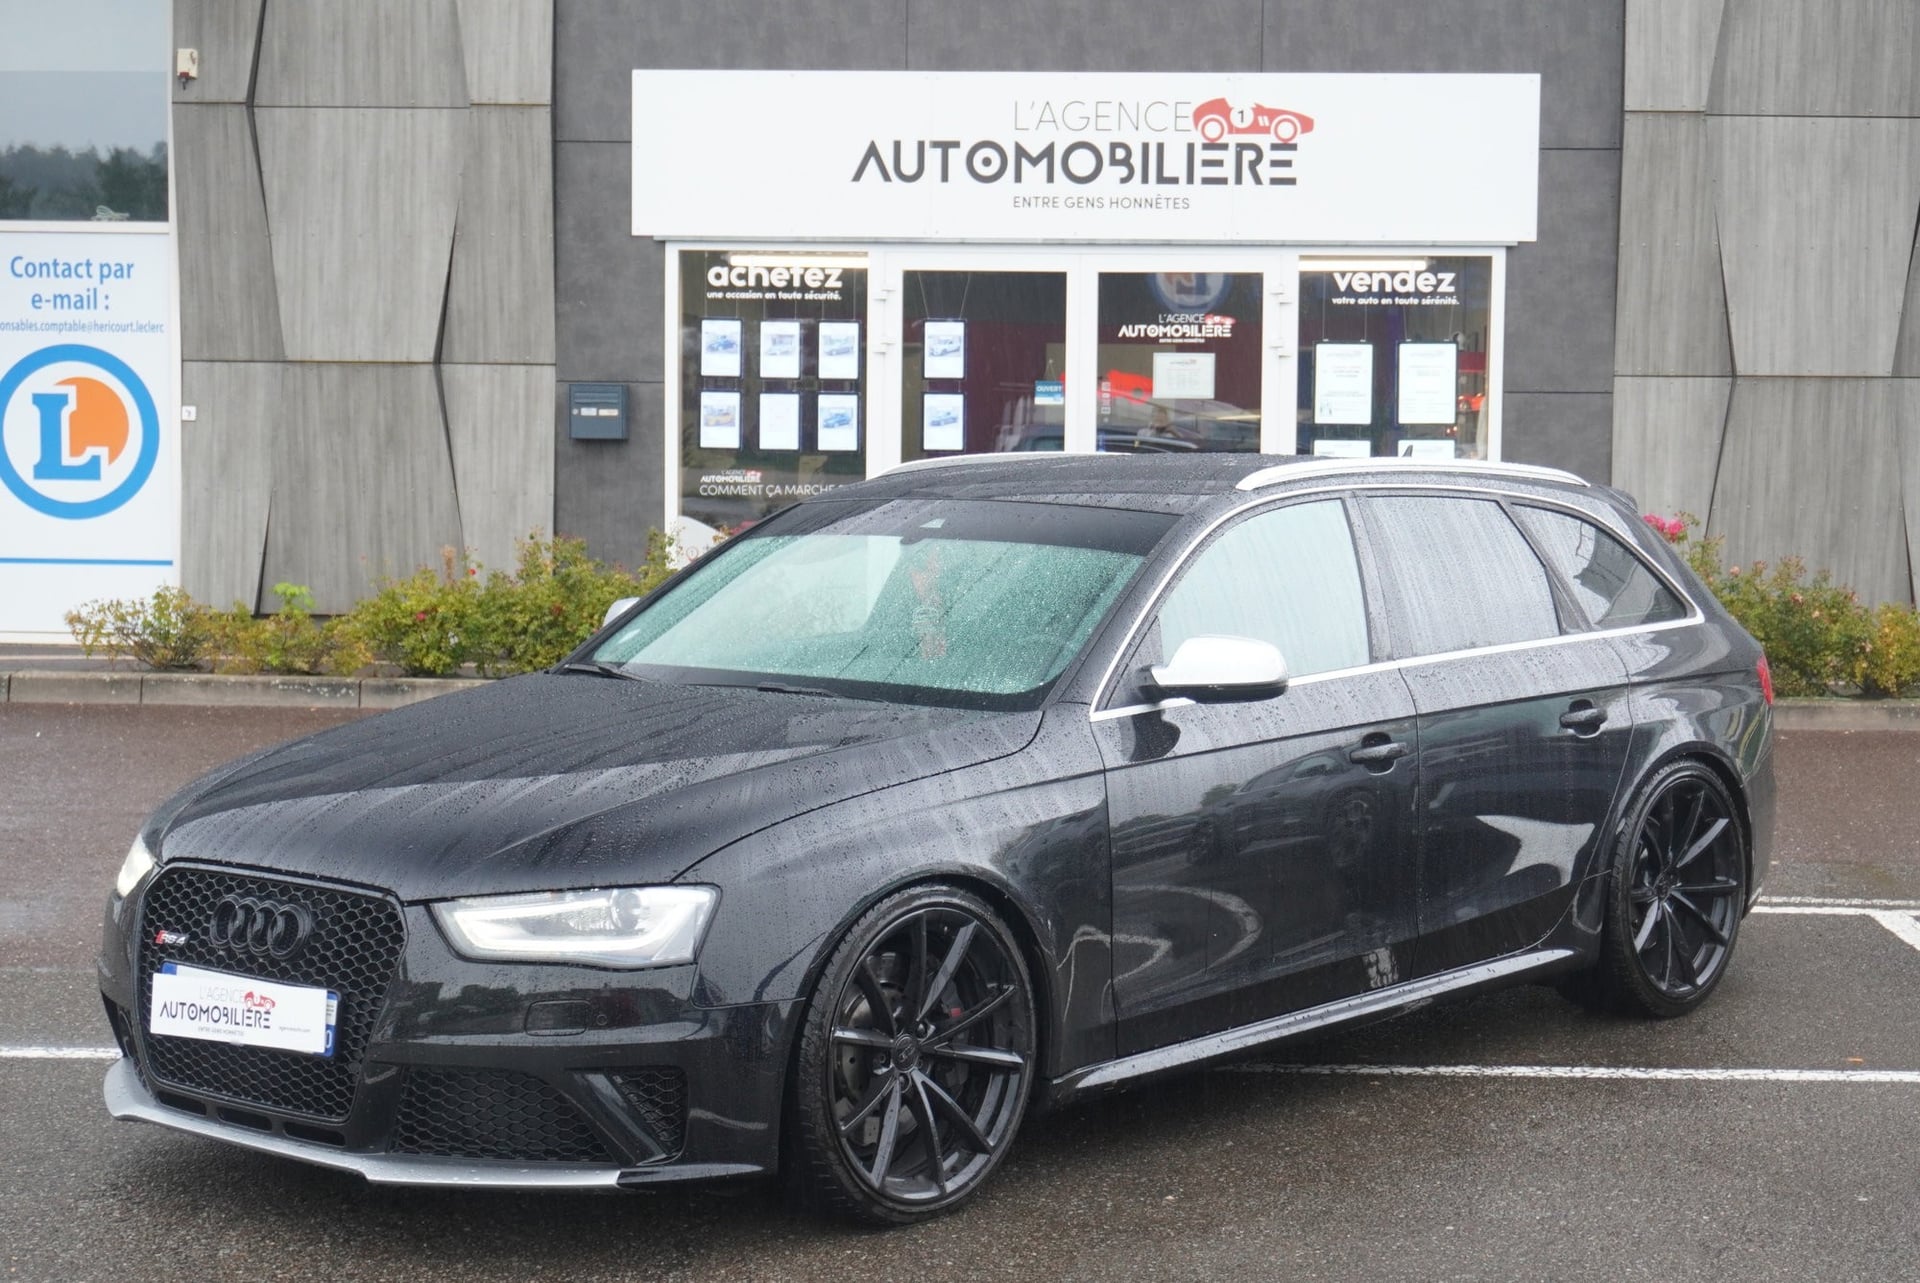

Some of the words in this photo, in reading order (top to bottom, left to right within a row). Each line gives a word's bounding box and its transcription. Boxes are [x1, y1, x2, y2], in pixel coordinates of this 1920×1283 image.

[1013, 100, 1192, 132] L'AGENCE
[851, 139, 1298, 186] AUTOMOBILIERE
[1013, 196, 1059, 209] ENTRE
[1064, 197, 1105, 209] GENS
[1109, 193, 1191, 210] HONNÊTES
[10, 255, 93, 279] Contact
[99, 260, 135, 285] par
[706, 263, 843, 289] achetez
[1332, 268, 1456, 293] vendez
[30, 287, 98, 311] e-mail
[707, 291, 723, 299] une
[725, 290, 763, 300] occasion
[764, 291, 776, 299] en
[778, 290, 802, 300] toute
[1332, 296, 1356, 305] votre
[1357, 296, 1379, 305] auto
[1381, 297, 1393, 305] en
[1395, 296, 1419, 305] toute
[1158, 313, 1205, 324] L'AGENCE
[1036, 385, 1063, 393] OUVERT
[700, 484, 764, 496] COMMENT
[766, 484, 783, 498] ÇA
